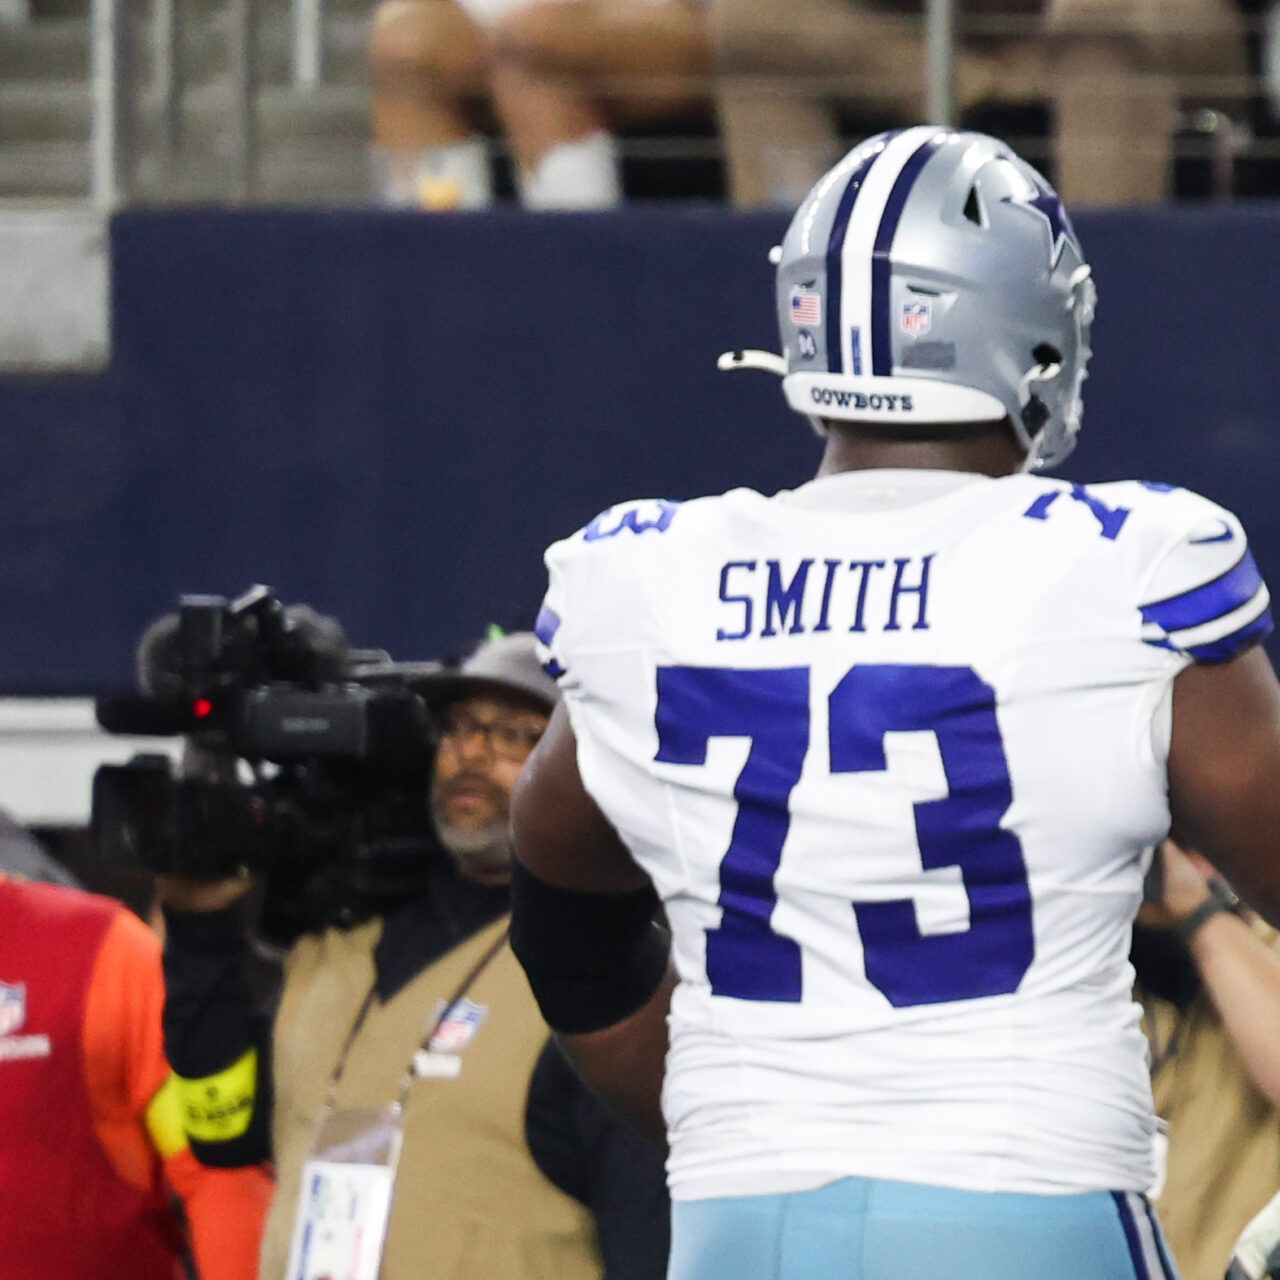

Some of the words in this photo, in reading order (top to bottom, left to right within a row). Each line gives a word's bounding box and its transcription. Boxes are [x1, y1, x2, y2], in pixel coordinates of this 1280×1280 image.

[811, 387, 915, 411] COWBOYS
[715, 553, 937, 643] SMITH
[653, 663, 1036, 1009] 73
